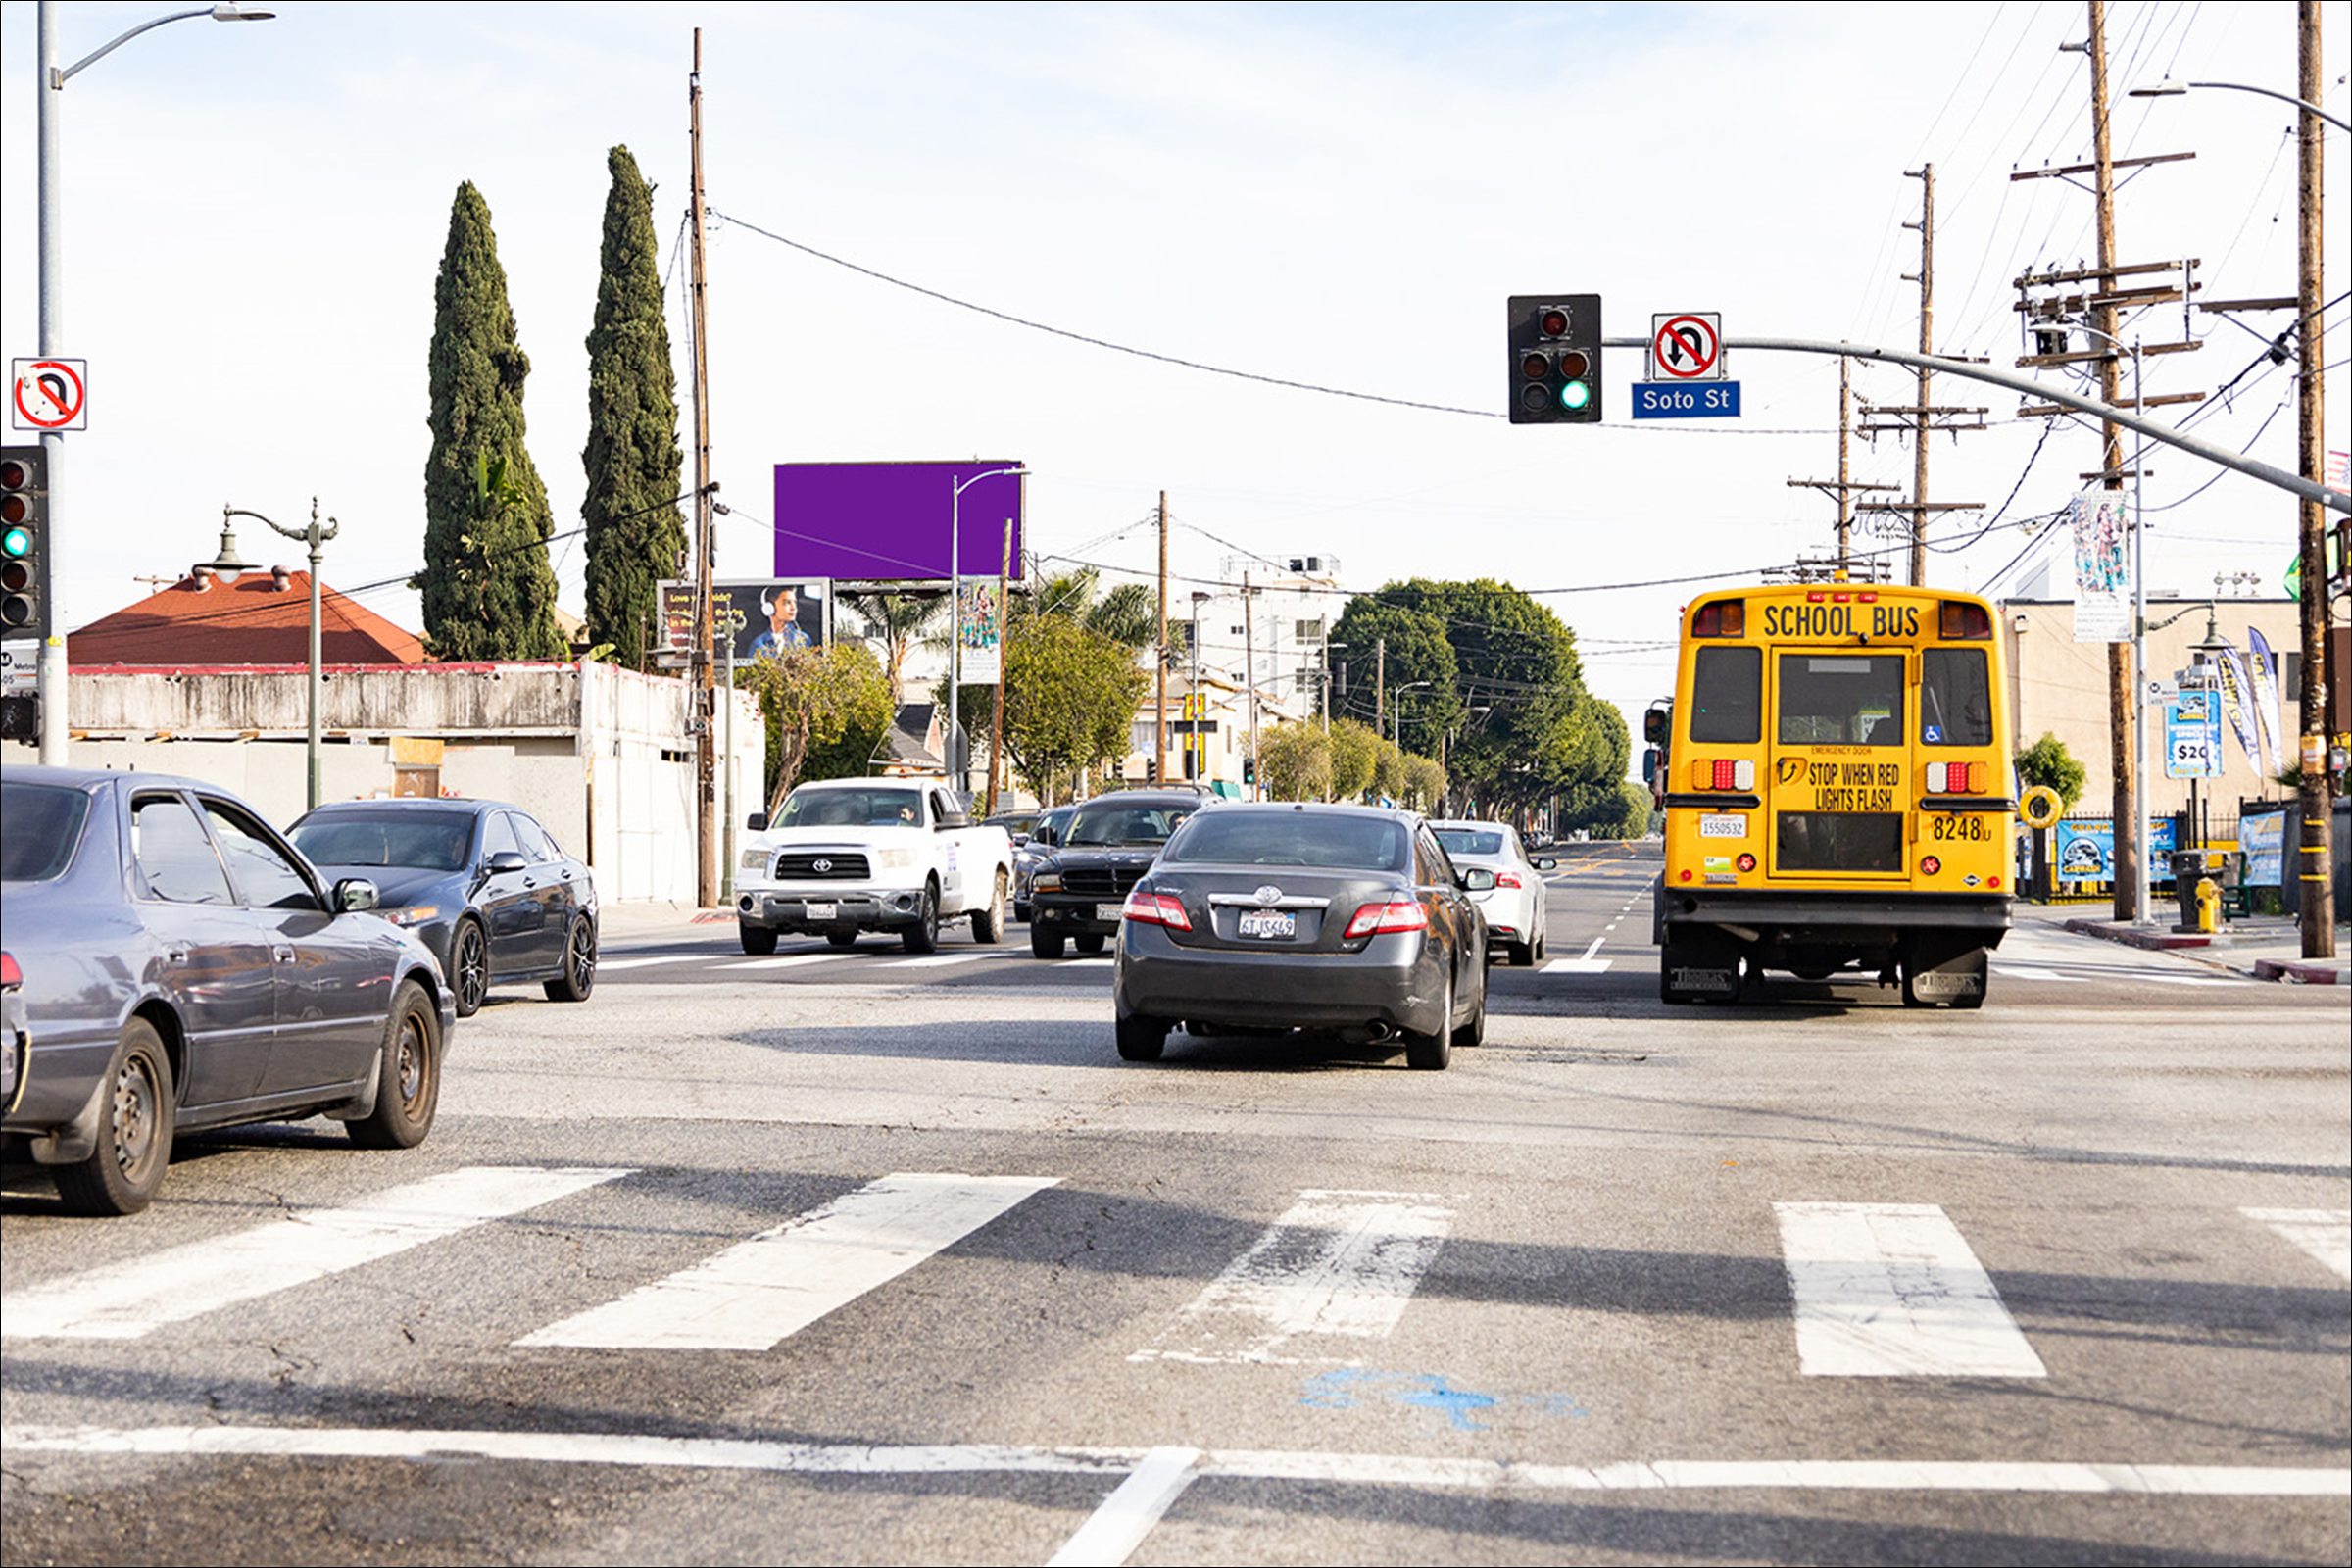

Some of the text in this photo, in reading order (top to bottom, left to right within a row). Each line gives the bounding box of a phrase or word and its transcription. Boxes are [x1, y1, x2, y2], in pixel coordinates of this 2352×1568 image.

[1643, 389, 1730, 410] Soto St
[1764, 606, 1919, 637] SCHOOL BUS
[2178, 744, 2209, 760] $20
[1809, 762, 1899, 786] STOP WHEN RED
[1816, 788, 1892, 810] LIGHTS FLASH
[1703, 822, 1742, 835] 1550532
[1934, 817, 1991, 841] 8248 U
